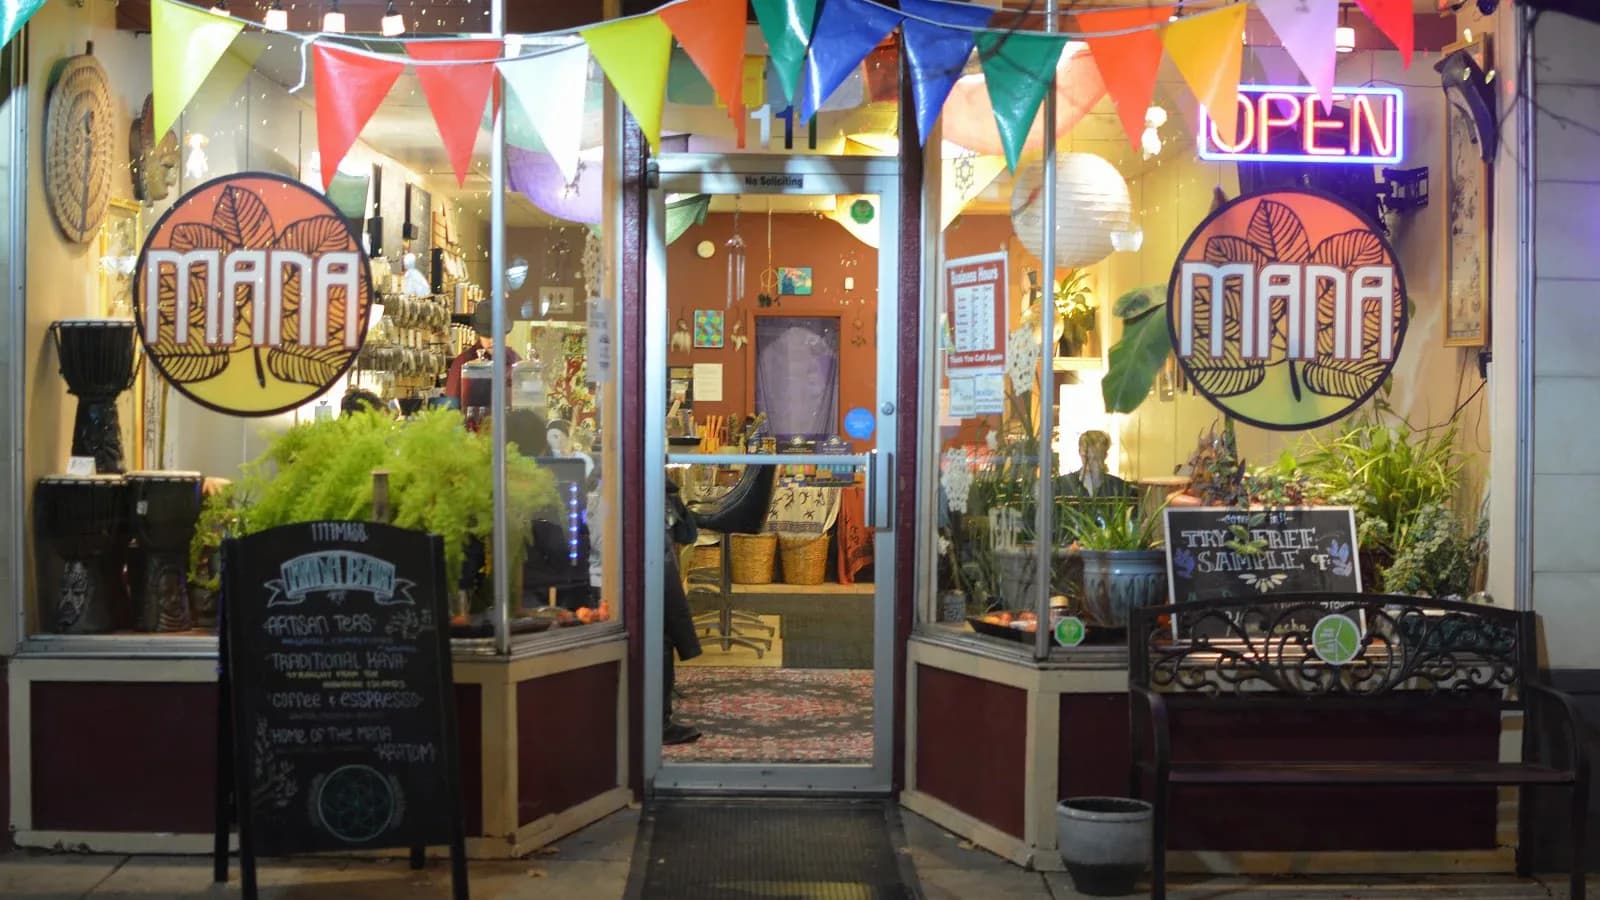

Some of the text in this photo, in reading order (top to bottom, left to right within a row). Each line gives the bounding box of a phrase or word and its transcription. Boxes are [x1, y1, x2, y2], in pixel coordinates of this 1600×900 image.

[1211, 93, 1394, 156] OPEN
[745, 175, 804, 189] No Soliciting
[146, 249, 360, 348] MANA
[1180, 261, 1394, 361] MANA
[1181, 529, 1227, 549] TRY
[1250, 527, 1318, 550] FREE
[1198, 549, 1304, 573] SAMPLE
